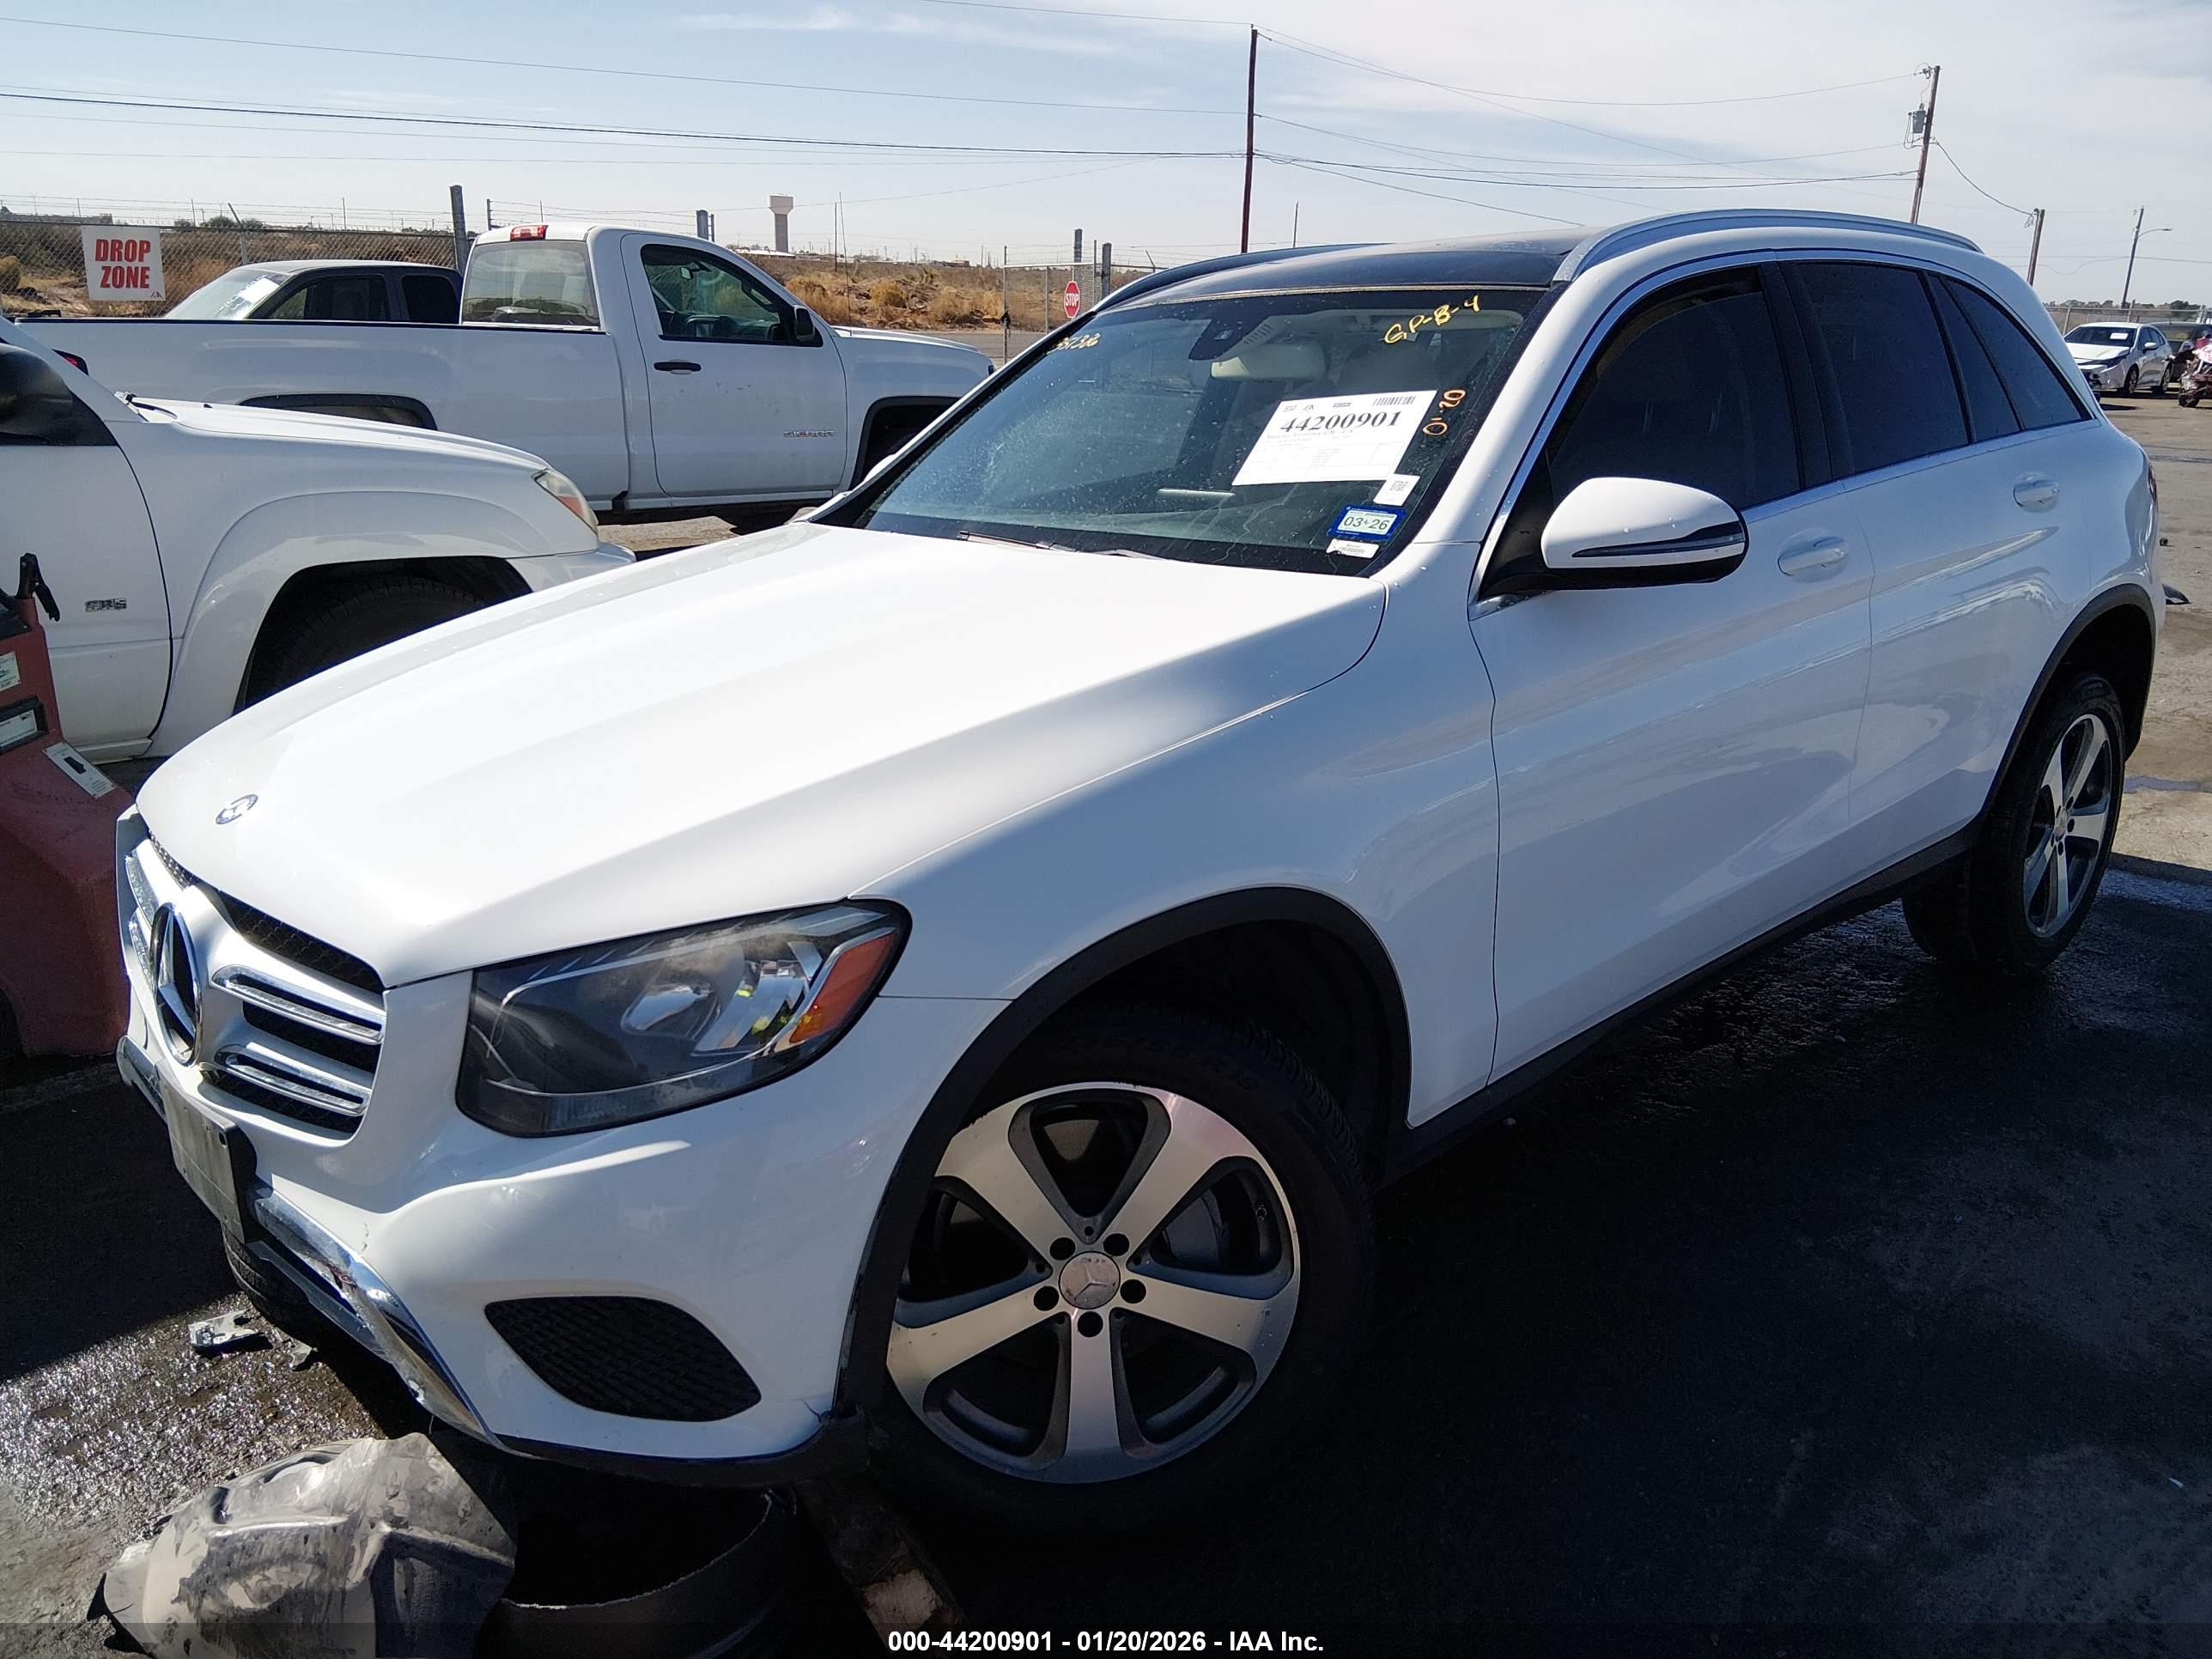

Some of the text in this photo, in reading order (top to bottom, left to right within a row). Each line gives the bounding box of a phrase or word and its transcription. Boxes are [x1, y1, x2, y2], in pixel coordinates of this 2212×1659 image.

[94, 238, 151, 263] DROP
[100, 264, 150, 289] ZONE
[1065, 293, 1079, 307] STOP
[1279, 410, 1401, 433] 44200901
[1343, 515, 1390, 531] 03 26
